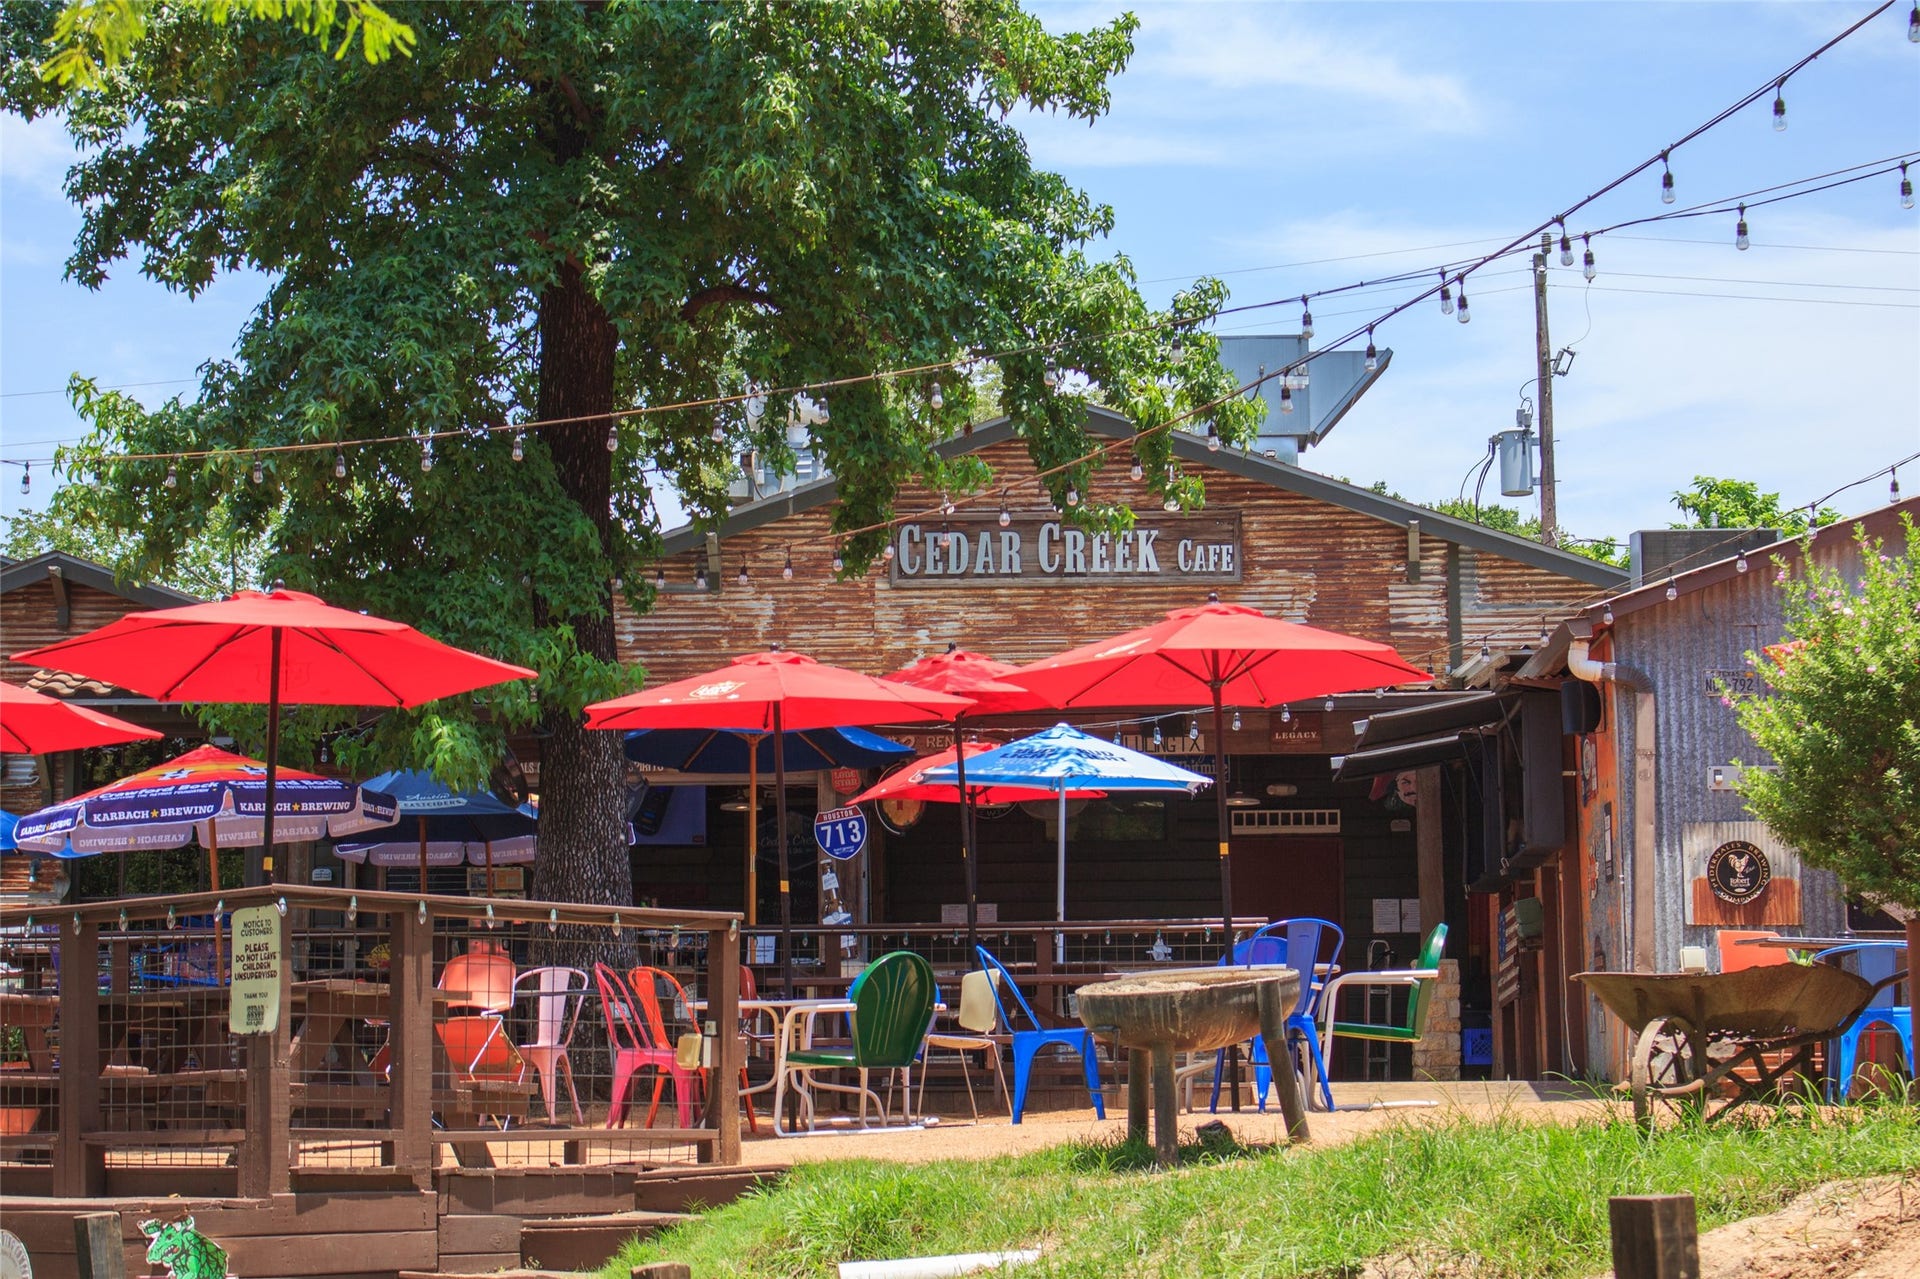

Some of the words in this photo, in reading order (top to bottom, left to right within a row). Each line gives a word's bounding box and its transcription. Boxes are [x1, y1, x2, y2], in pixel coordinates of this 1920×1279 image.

[899, 523, 1022, 575] CEDAR
[1038, 522, 1160, 574] CREEK
[1177, 539, 1234, 572] CAFE
[1275, 732, 1318, 740] LEGACY
[239, 803, 291, 812] KARCH
[300, 802, 350, 812] BREWING
[93, 810, 149, 823] KARBACH
[160, 805, 214, 818] BREWING
[823, 810, 854, 820] HOUSTON
[820, 820, 861, 848] 713
[1748, 845, 1769, 886] BREWING
[243, 919, 264, 928] NOTICE
[265, 919, 272, 927] TO
[244, 943, 269, 953] PLEASE
[235, 954, 245, 963] DO
[246, 953, 259, 962] NOT
[260, 952, 277, 961] LEAVE
[242, 961, 271, 971] CHILDREN
[234, 971, 278, 981] UNSUPERVISED
